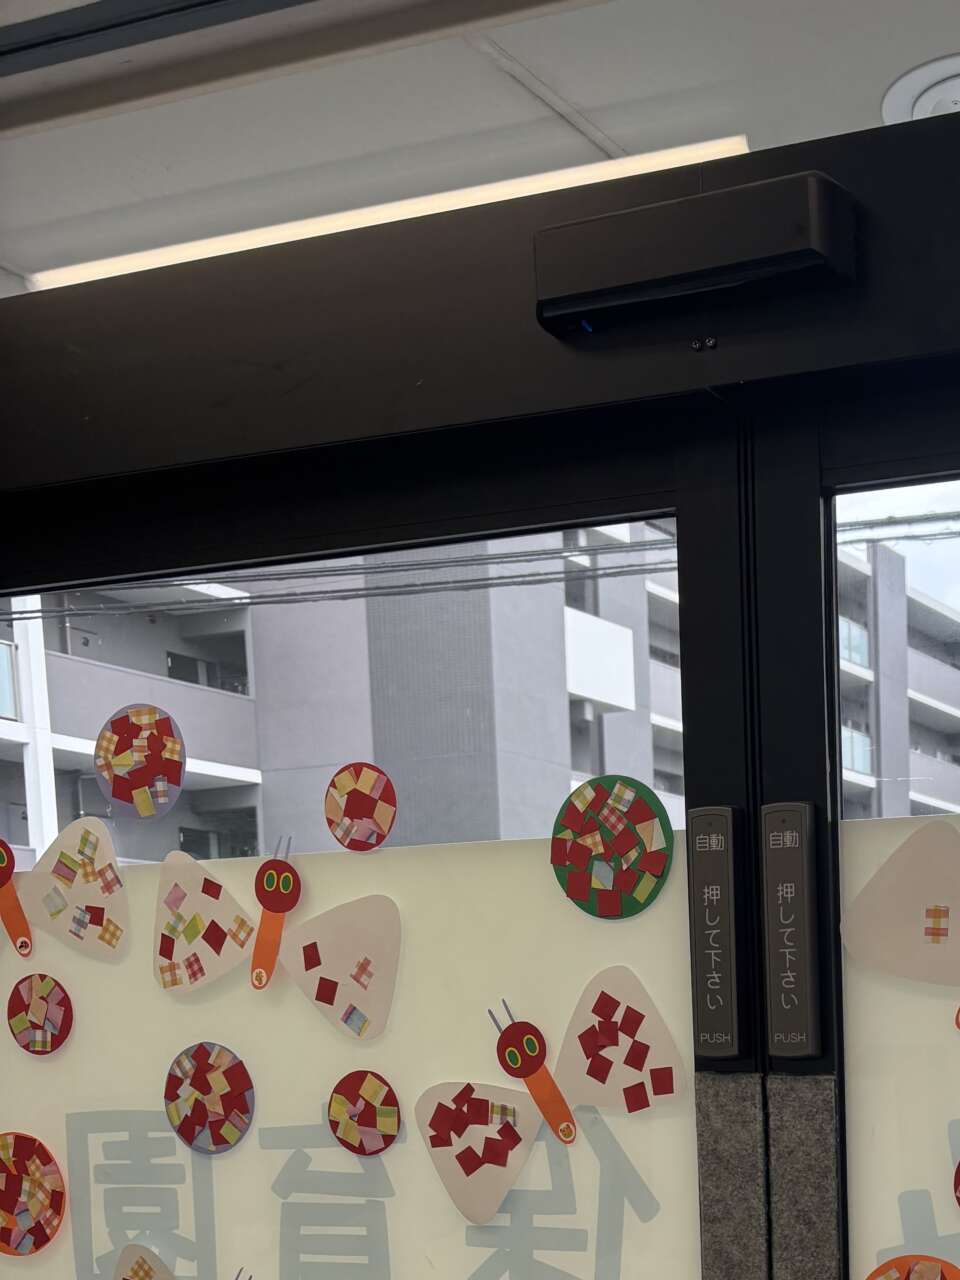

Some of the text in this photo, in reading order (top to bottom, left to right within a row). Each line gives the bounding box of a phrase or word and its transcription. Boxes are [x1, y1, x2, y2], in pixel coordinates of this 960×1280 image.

[695, 833, 725, 851] 自動
[769, 830, 800, 849] 自動
[703, 885, 724, 1010] 押して下さい
[776, 883, 798, 1009] 押して下さい
[700, 1032, 731, 1043] PUSH
[774, 1032, 806, 1043] PUSH
